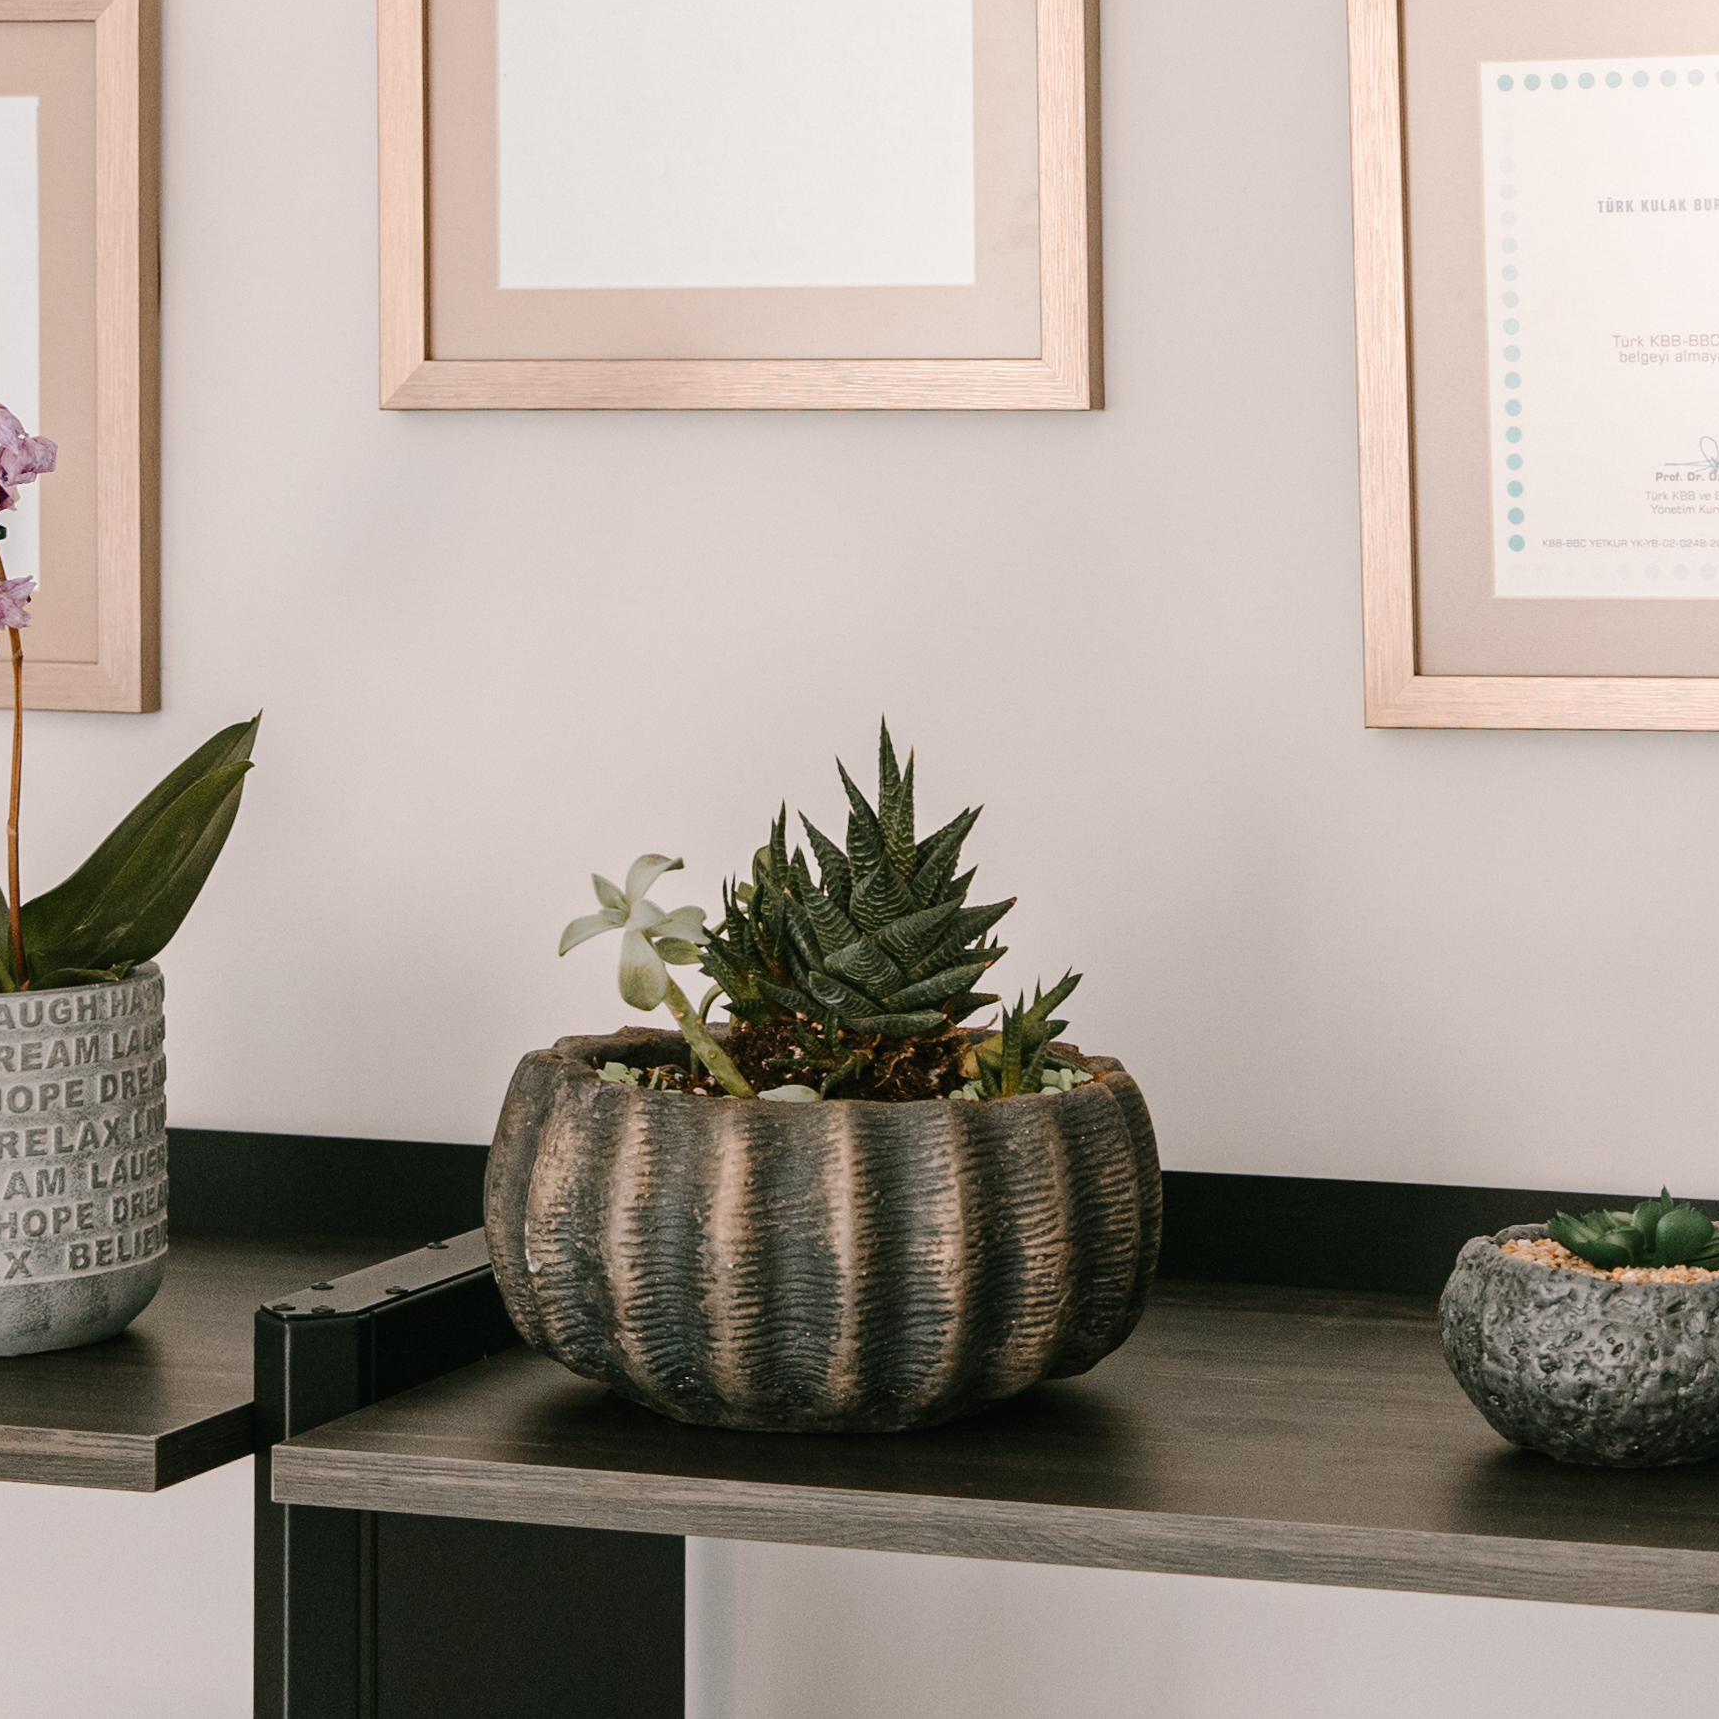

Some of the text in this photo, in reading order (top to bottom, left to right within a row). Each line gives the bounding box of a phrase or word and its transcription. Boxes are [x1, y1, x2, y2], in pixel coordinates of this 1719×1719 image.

[1597, 197, 1634, 213] TÜRK
[1641, 199, 1686, 212] KULAK
[1612, 335, 1644, 348] Türk
[1650, 334, 1719, 347] KBB-BBC
[1619, 351, 1669, 366] belgeyi
[1655, 472, 1682, 481] Prof.
[1687, 472, 1704, 481] Dr.
